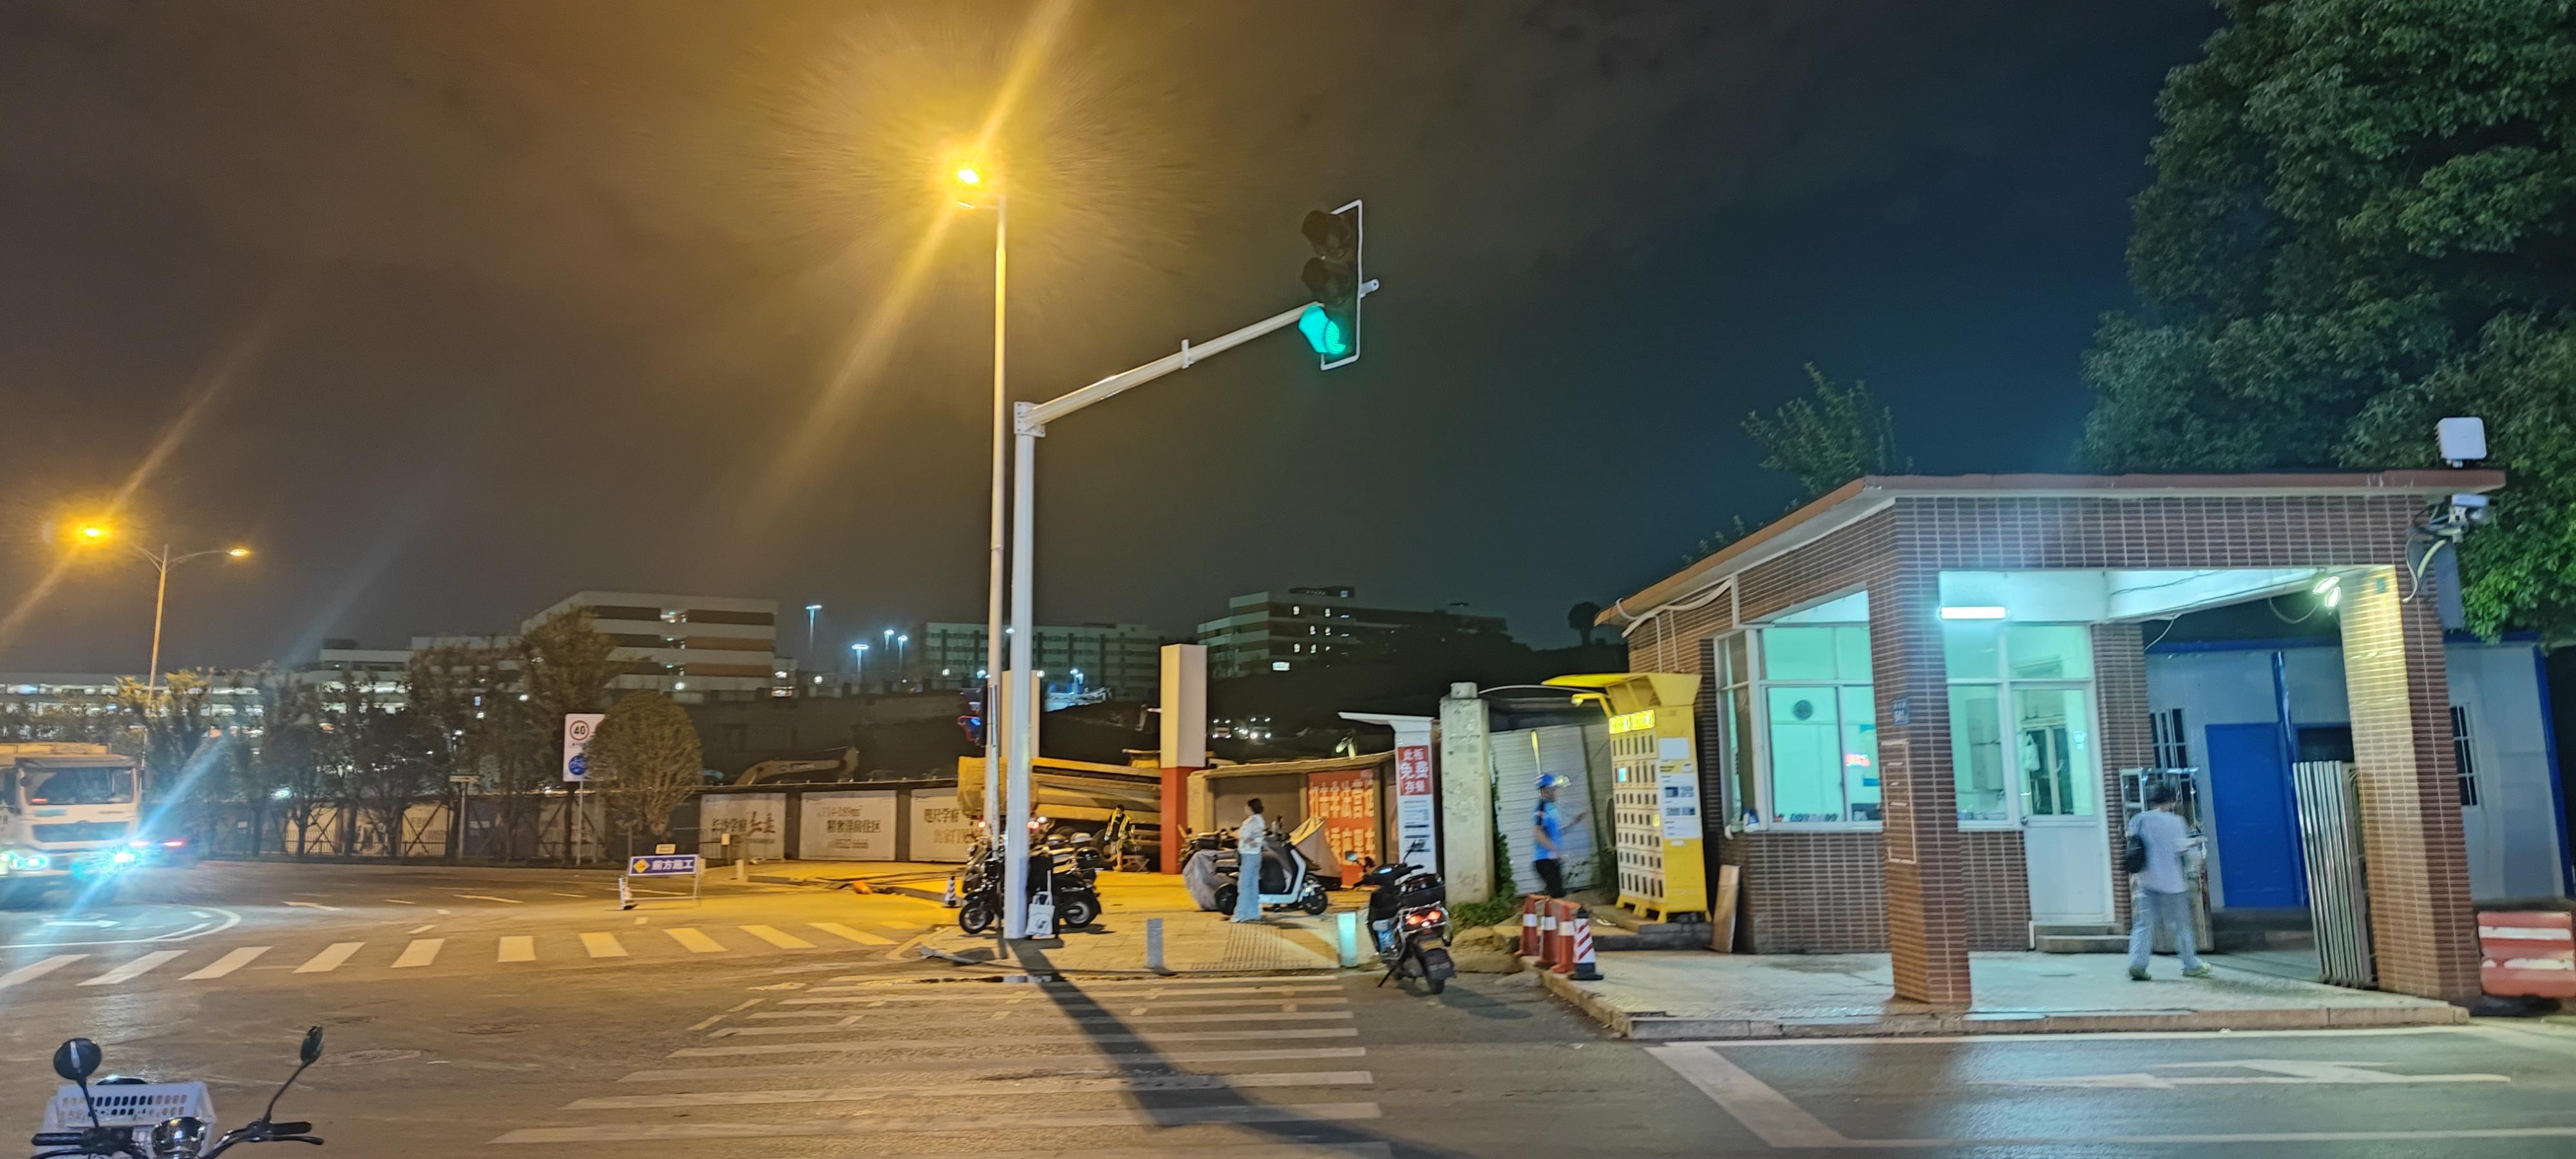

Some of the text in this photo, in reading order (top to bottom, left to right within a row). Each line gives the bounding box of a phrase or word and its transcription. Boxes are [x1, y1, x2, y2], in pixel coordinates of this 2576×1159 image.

[574, 725, 586, 735] 40
[1399, 760, 1429, 780] 免费
[651, 859, 694, 871] 前方施工
